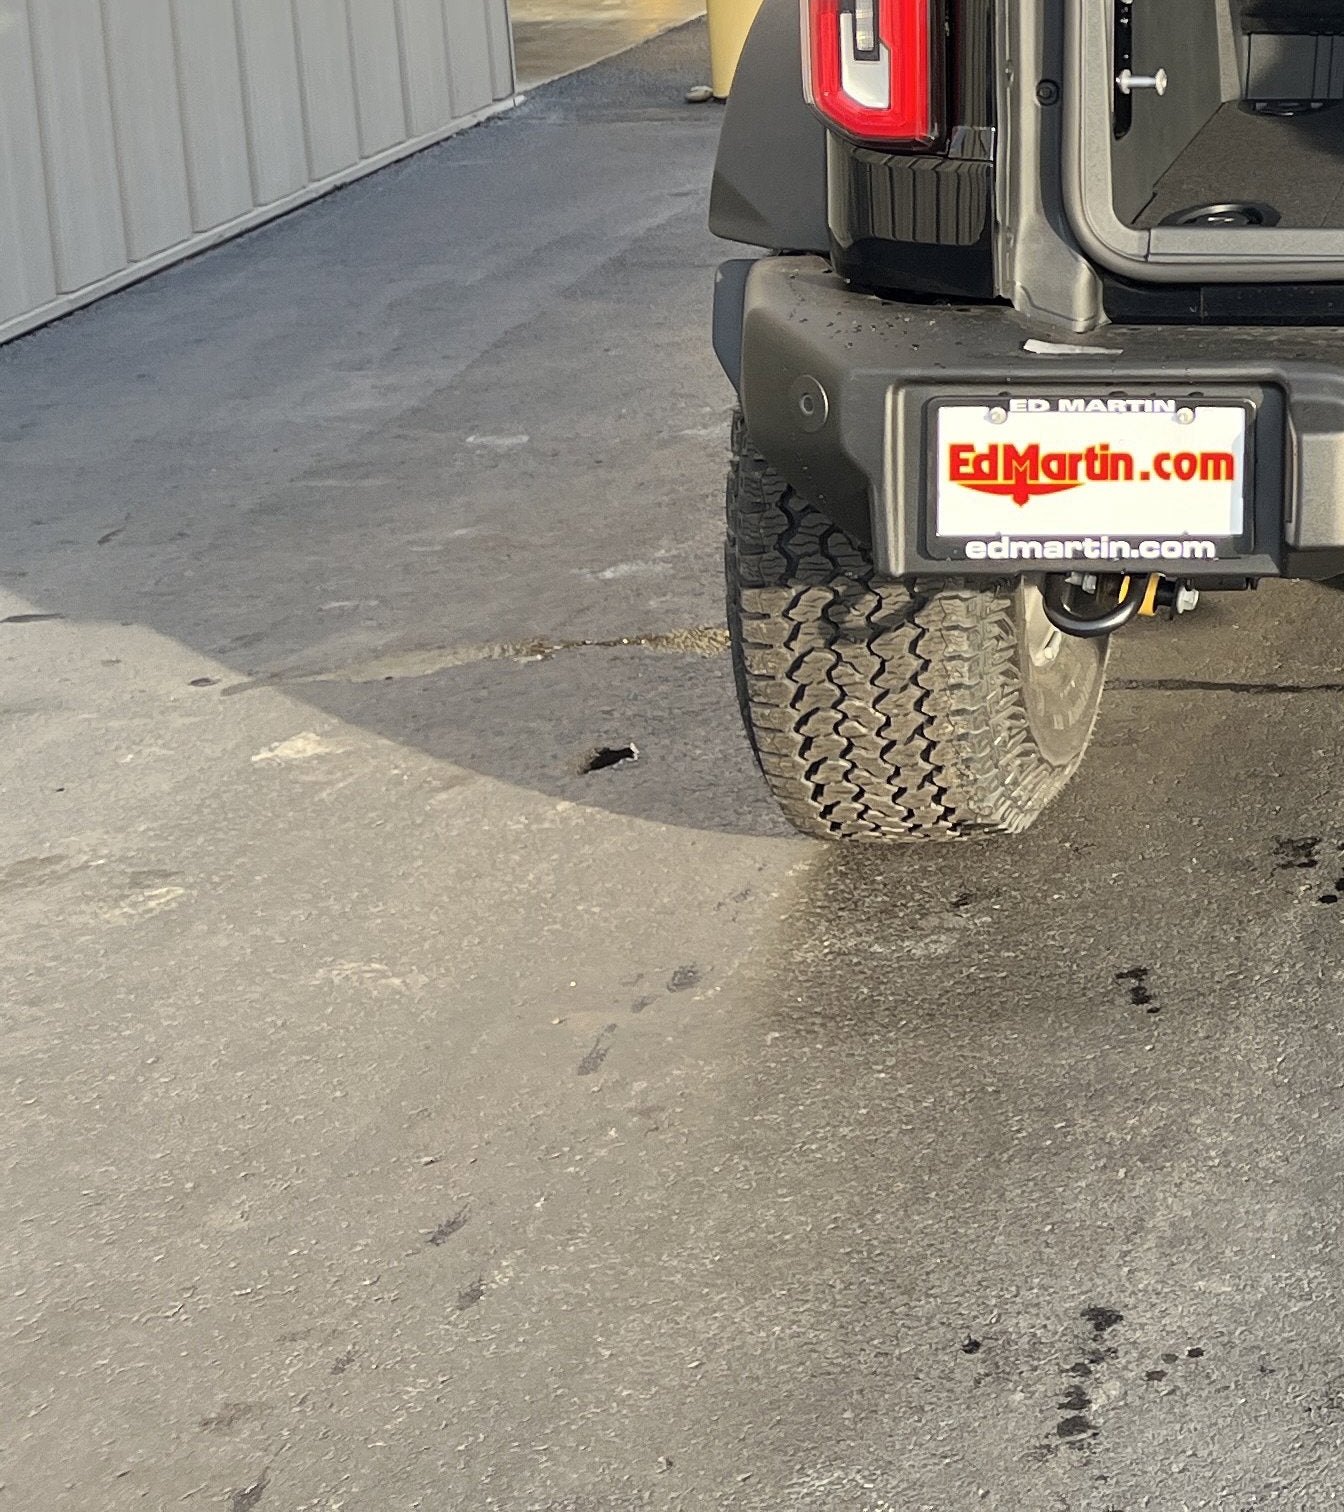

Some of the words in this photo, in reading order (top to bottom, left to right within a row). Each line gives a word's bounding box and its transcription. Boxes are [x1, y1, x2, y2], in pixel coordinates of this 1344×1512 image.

[1009, 399, 1050, 412] ED
[1058, 399, 1176, 413] MARTIN
[949, 443, 1235, 482] EdMartin.com
[965, 536, 1216, 559] edmartin.com
